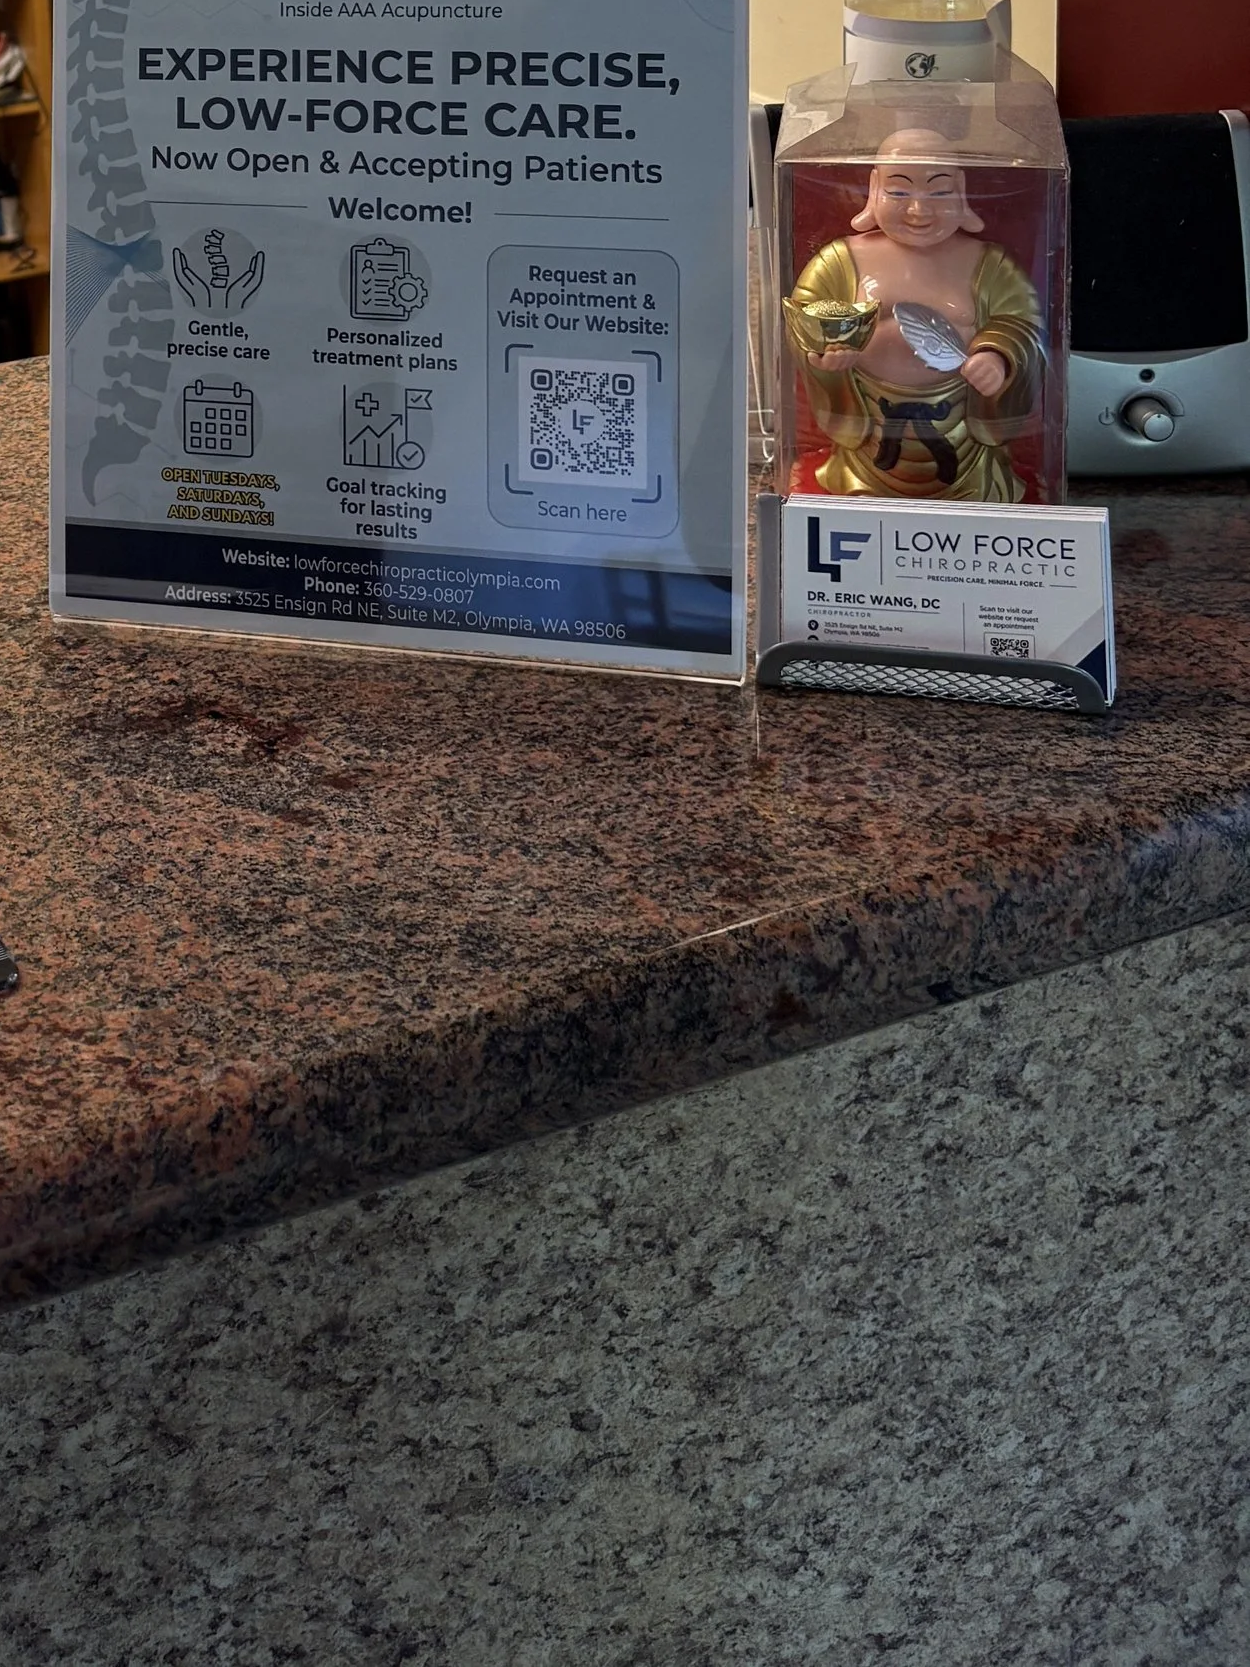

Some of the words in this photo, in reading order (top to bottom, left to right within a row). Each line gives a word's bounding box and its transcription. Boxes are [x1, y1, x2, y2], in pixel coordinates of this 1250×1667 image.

[280, 2, 333, 17] Inside
[337, 2, 376, 17] AAA
[381, 2, 502, 22] Acupuncture
[139, 48, 433, 84] EXPERIENCE
[451, 51, 680, 95] PRECISE,
[176, 97, 468, 135] LOW-FORCE
[484, 102, 636, 139] CARE.
[152, 146, 218, 170] Now
[227, 147, 309, 177] Open
[319, 150, 340, 174] &
[348, 151, 512, 186] Accepting
[525, 155, 662, 184] Patients
[328, 196, 472, 224] Welcome!
[528, 266, 607, 287] Request
[613, 272, 637, 285] an
[509, 289, 637, 310] Appointment
[643, 294, 656, 310] &
[188, 320, 249, 340] Gentle,
[497, 311, 539, 329] Visit
[544, 313, 580, 331] Our
[585, 315, 669, 335] Website:
[326, 328, 442, 348] Personalized
[166, 342, 228, 358] precise
[233, 347, 270, 360] care
[312, 350, 404, 368] treatment
[408, 354, 458, 372] plans
[161, 468, 202, 484] OPEN
[202, 470, 280, 491] TUESDAYS,
[176, 487, 265, 508] SATURDAYS,
[326, 477, 366, 495] Goal
[370, 482, 447, 504] tracking
[167, 505, 202, 520] AND
[202, 508, 274, 526] SUNDAYS!
[340, 498, 364, 515] for
[370, 502, 432, 524] lasting
[538, 501, 580, 519] Scan
[586, 504, 627, 522] here
[356, 521, 418, 540] results
[895, 530, 962, 553] LOW
[974, 535, 1076, 560] FORCE
[222, 548, 290, 568] Website:
[294, 553, 561, 592] lowforcechiropracticolympia.com
[895, 556, 1076, 577] CHIROPRACTIC
[304, 576, 359, 595] Phone:
[364, 581, 474, 605] 360-529-0807
[927, 575, 964, 583] PRECISION
[988, 578, 1018, 586] MINIMAL
[807, 590, 830, 602] DR.
[835, 593, 866, 604] ERIC
[870, 594, 917, 609] WANG,
[921, 598, 941, 609] DC
[979, 605, 996, 613] Scan
[165, 585, 231, 604] Address:
[235, 590, 270, 608] 3525
[274, 594, 327, 616] Ensign
[332, 600, 352, 615] Rd
[357, 602, 383, 620] NE,
[387, 605, 428, 622] Suite
[432, 609, 460, 626] M2,
[465, 611, 537, 633] Olympia,
[540, 617, 571, 635] WA
[574, 621, 626, 639] 98506
[807, 609, 871, 618] CHIROPRACTOR
[1013, 615, 1038, 623] request
[993, 622, 1034, 631] appointment
